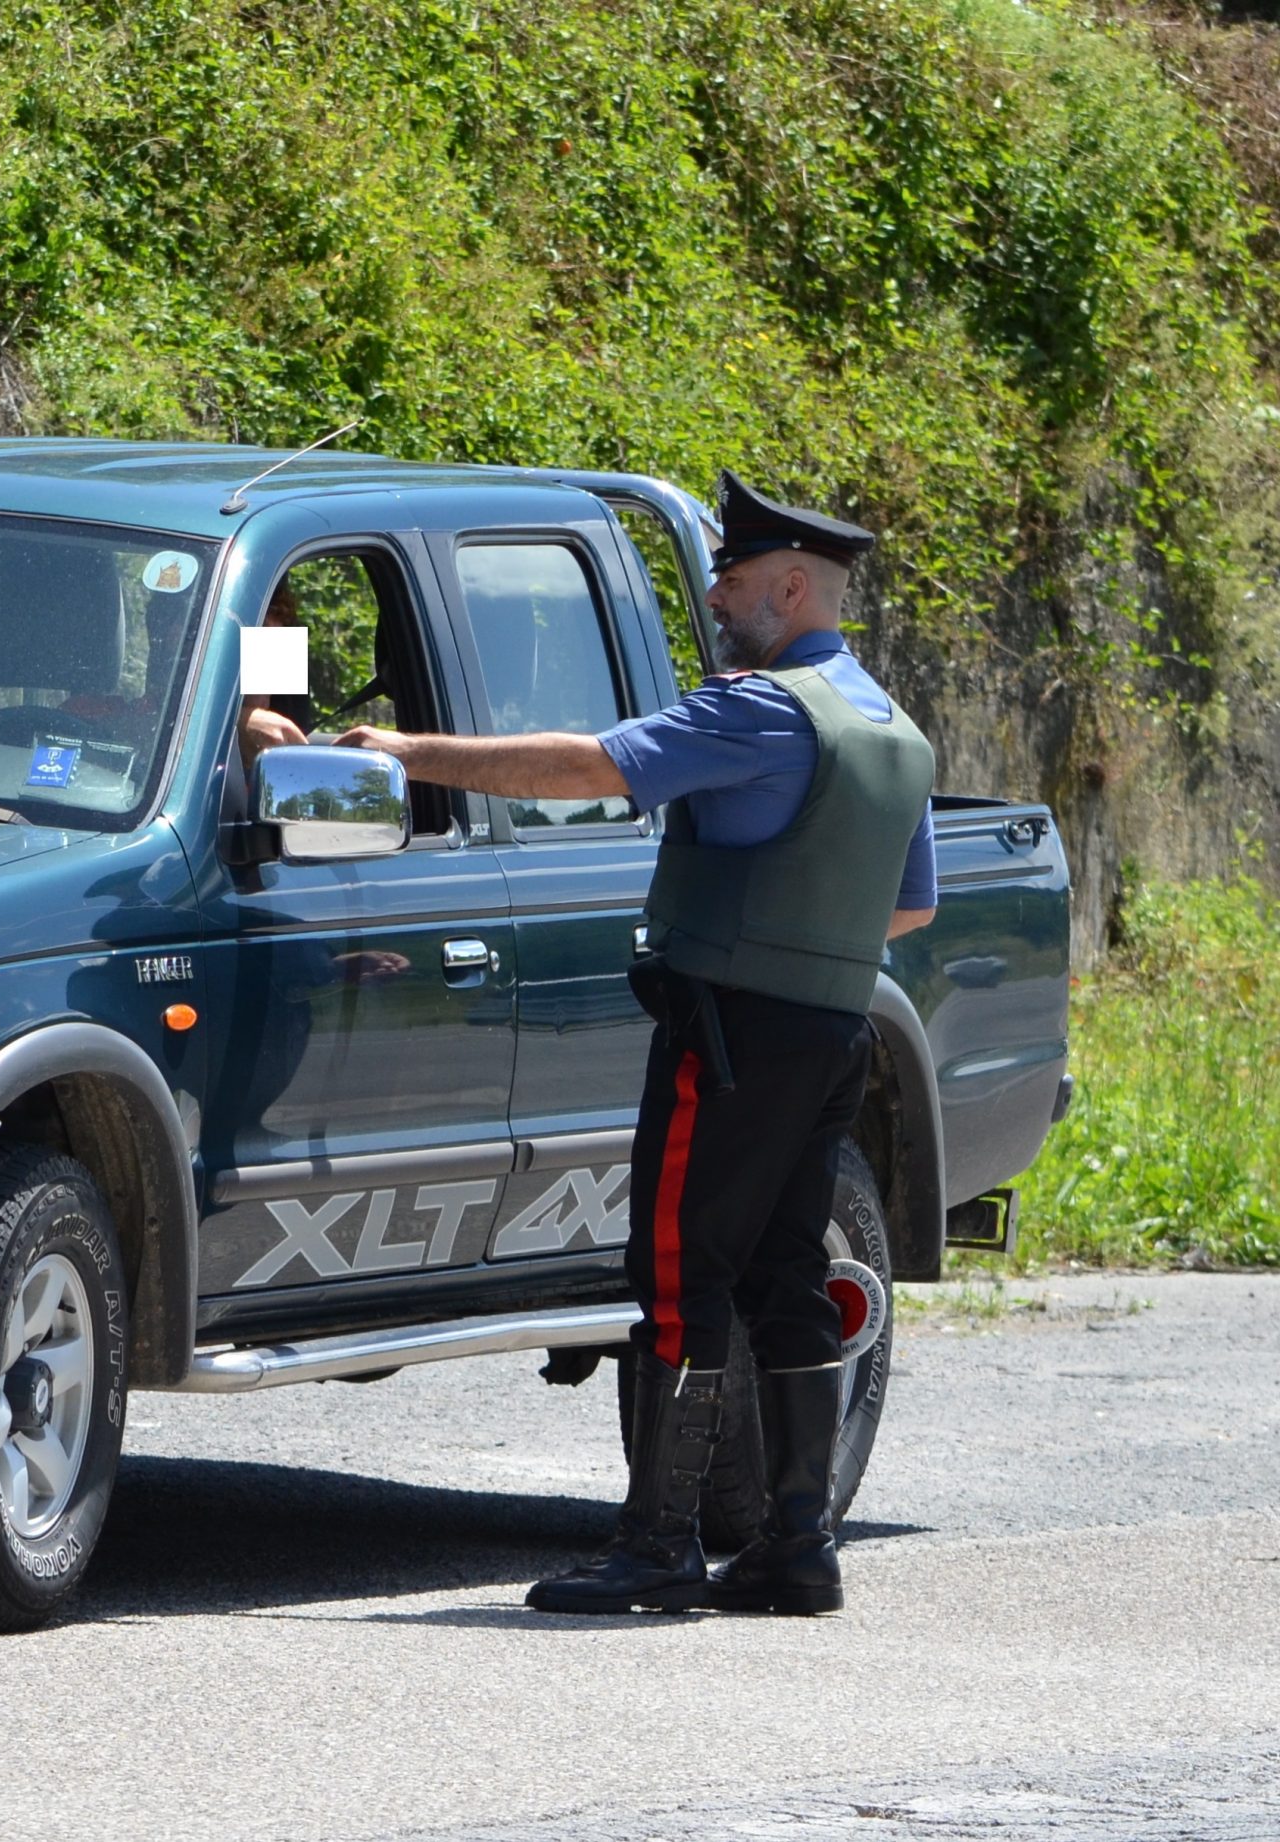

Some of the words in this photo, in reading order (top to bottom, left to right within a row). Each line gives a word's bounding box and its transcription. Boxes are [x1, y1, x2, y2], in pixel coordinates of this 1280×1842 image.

[470, 823, 490, 837] XLT
[231, 1178, 498, 1288] XLT
[867, 1288, 880, 1330] DIFESA
